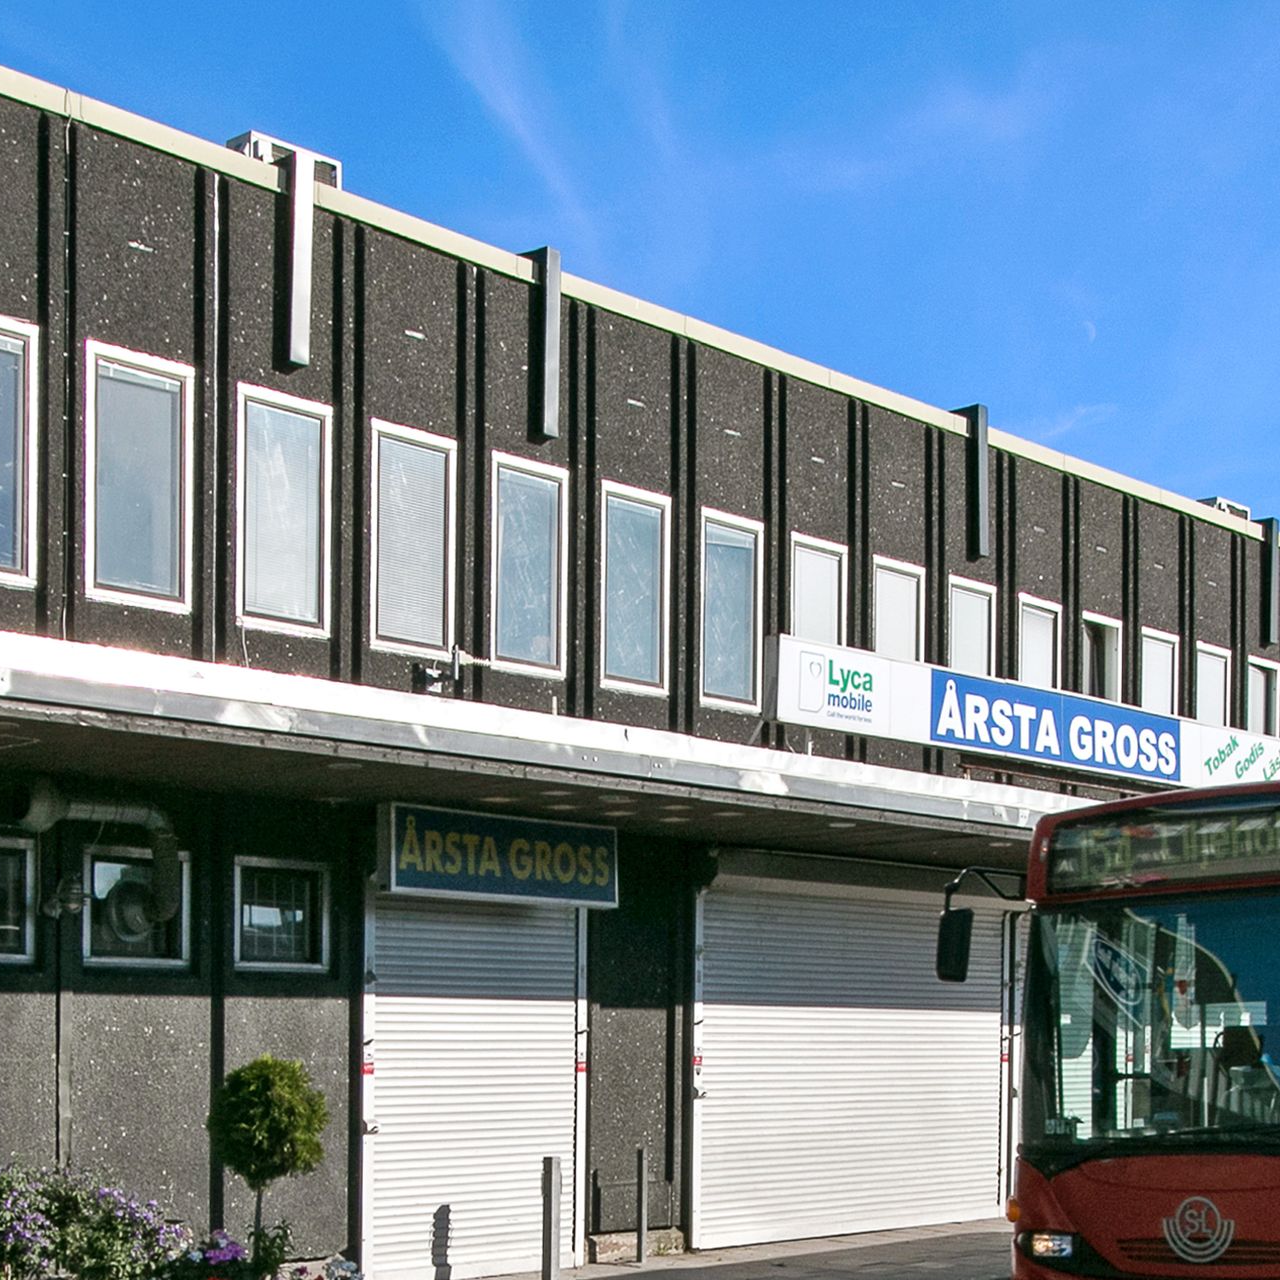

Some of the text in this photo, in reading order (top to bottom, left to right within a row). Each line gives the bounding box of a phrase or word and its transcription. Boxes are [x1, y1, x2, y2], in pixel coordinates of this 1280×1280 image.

[828, 659, 873, 693] Lyca
[827, 692, 873, 713] mobile
[936, 679, 1177, 775] ÅRSTA GROSS
[1204, 735, 1240, 776] Tobak
[1234, 742, 1265, 779] Godis
[399, 815, 610, 887] ÅRSTA GROSS
